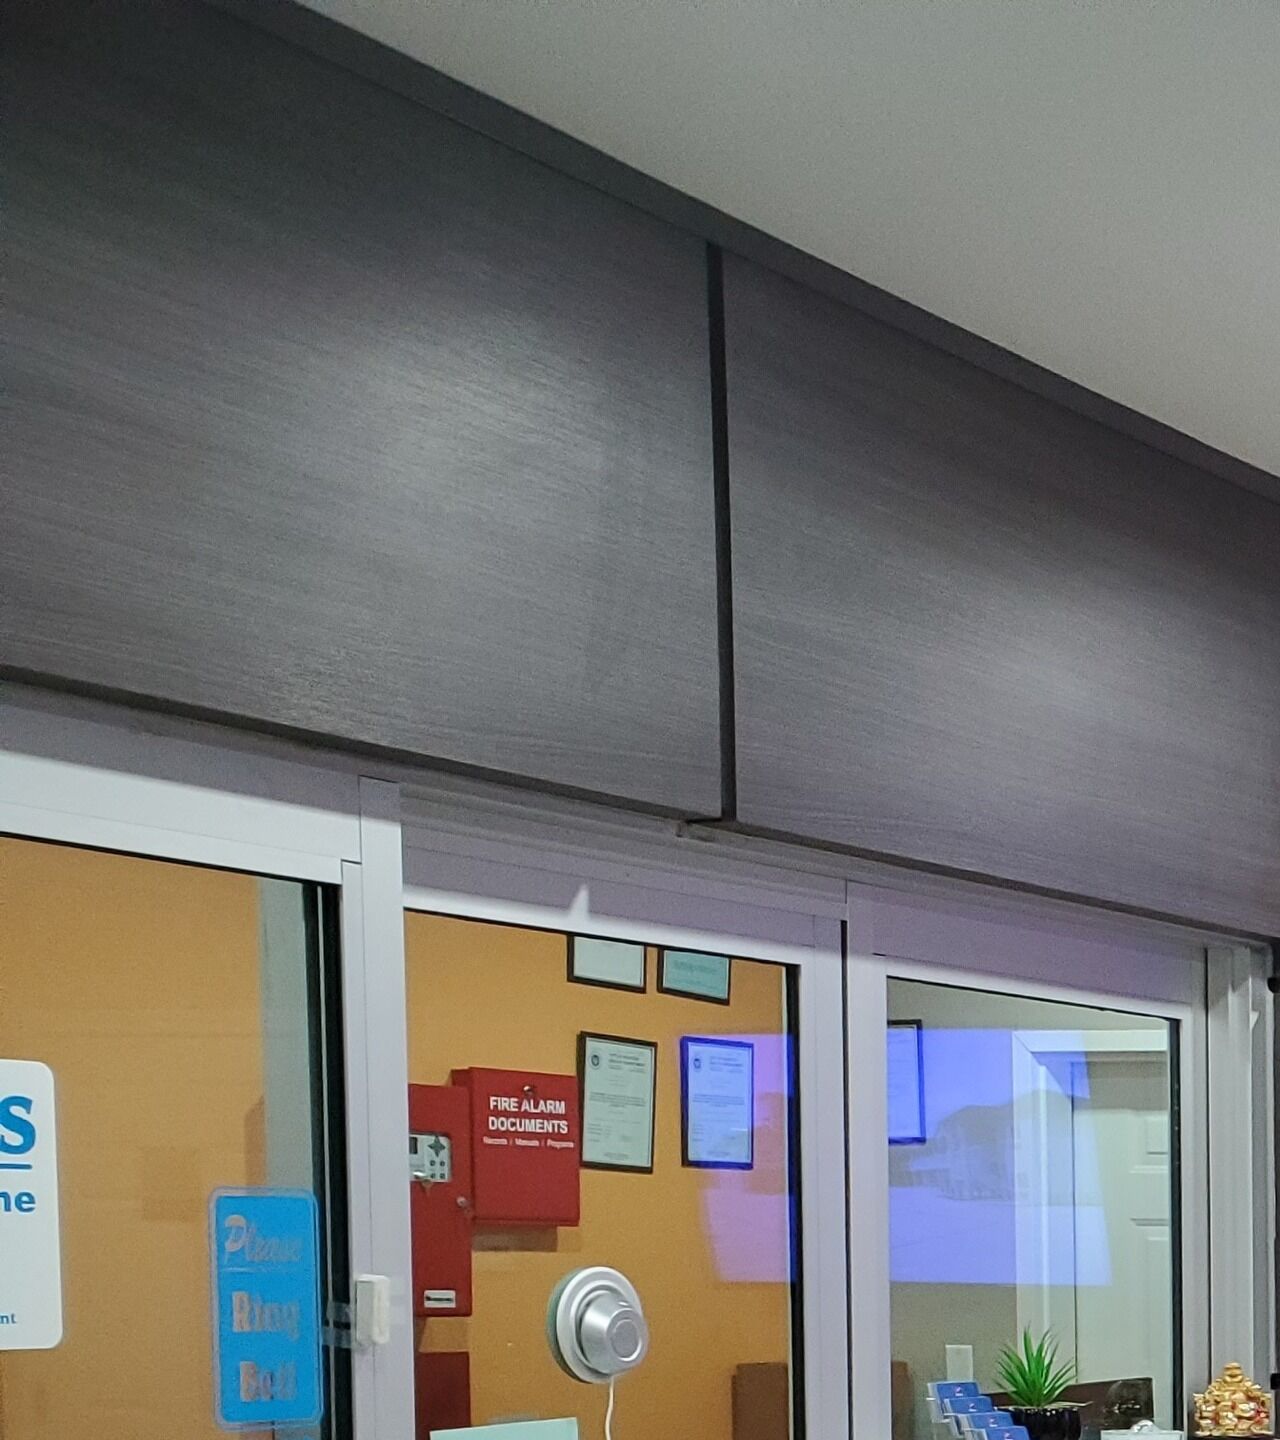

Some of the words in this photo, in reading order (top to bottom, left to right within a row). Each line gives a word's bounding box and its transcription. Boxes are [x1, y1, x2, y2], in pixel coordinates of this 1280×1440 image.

[489, 1096, 519, 1112] FIRE
[521, 1099, 566, 1114] ALARM
[488, 1116, 568, 1134] DOCUMENTS
[232, 1291, 298, 1342] Ring
[239, 1361, 297, 1402] Bell
